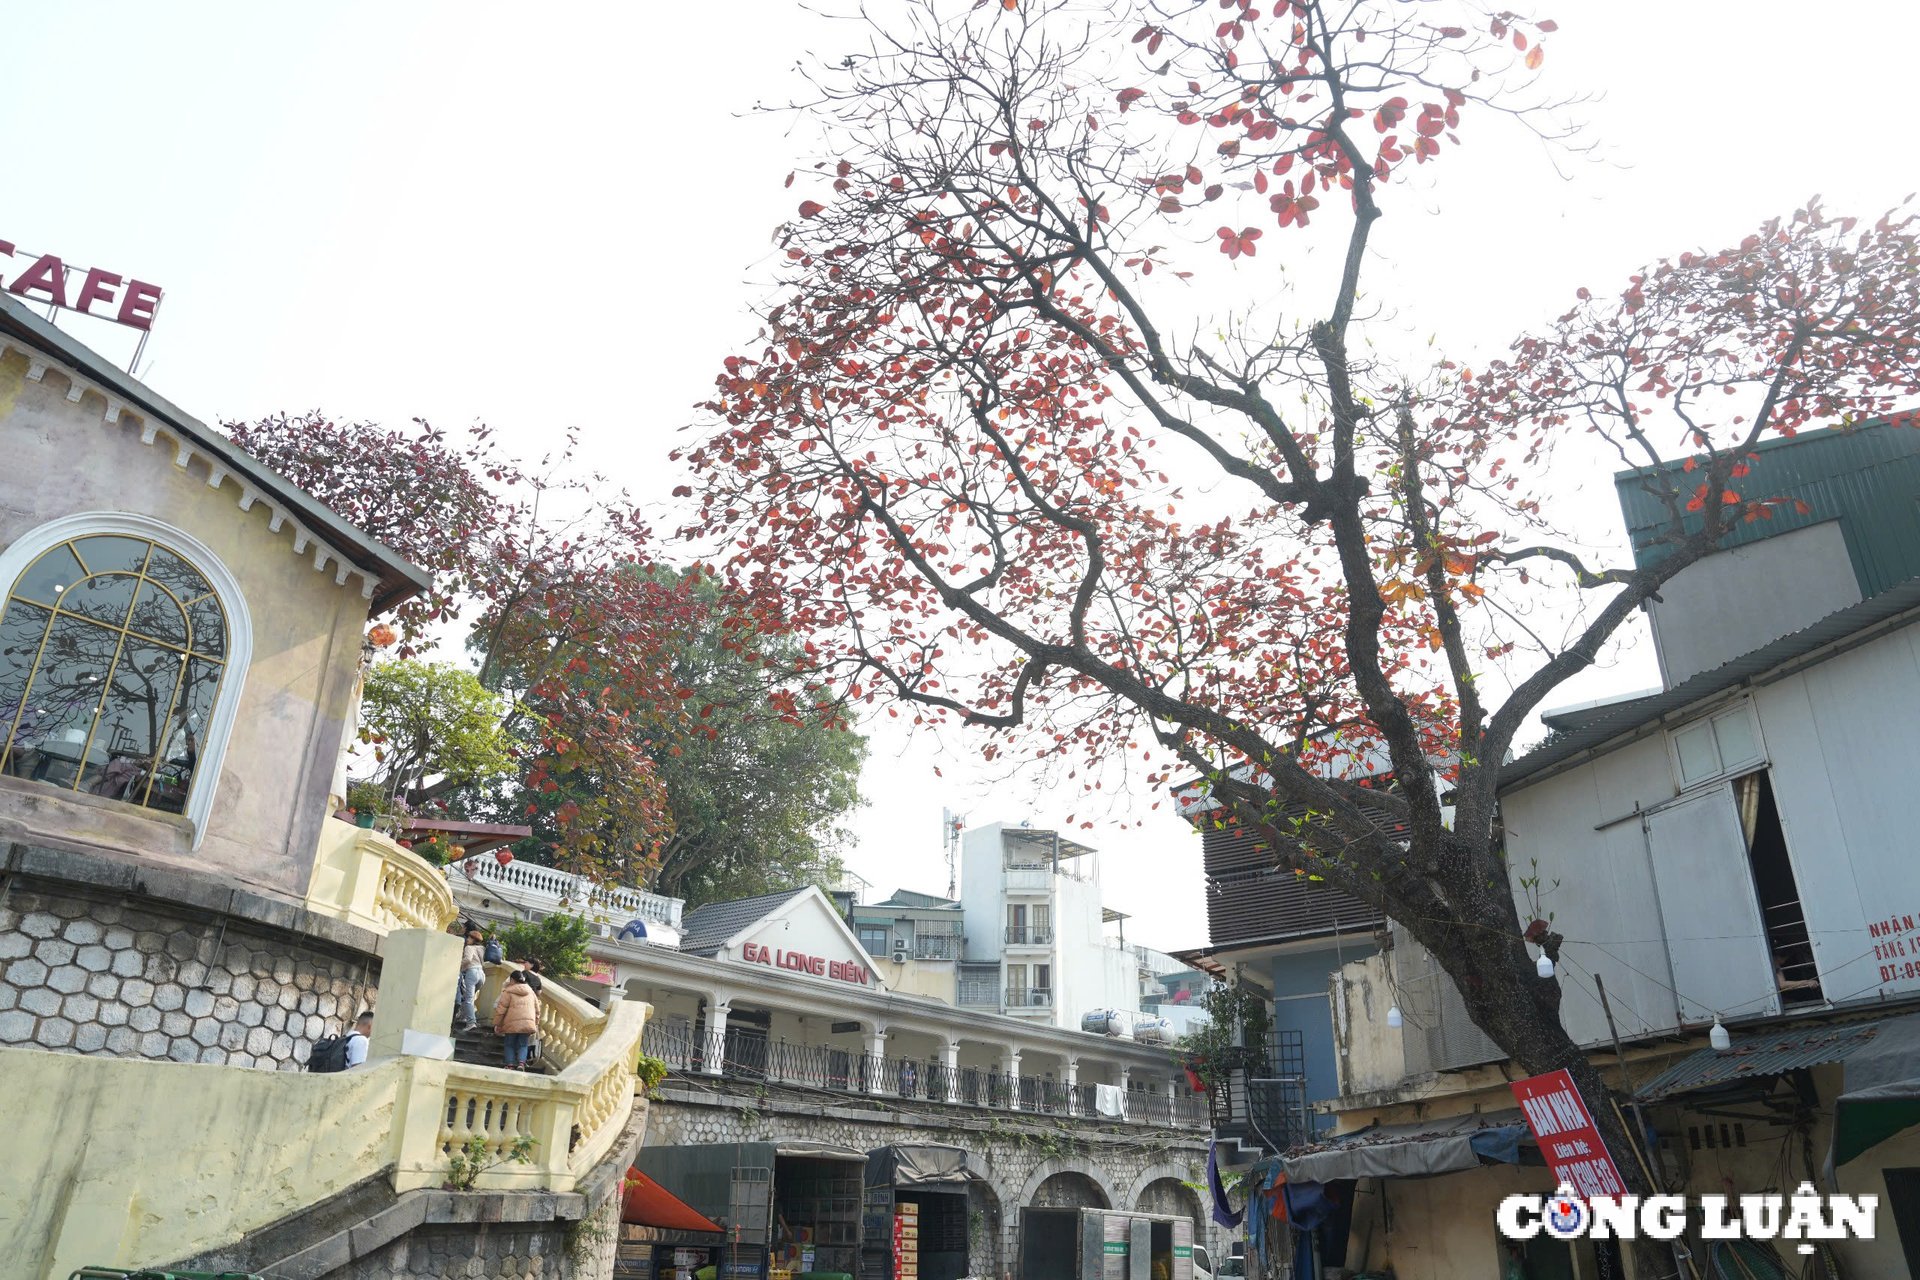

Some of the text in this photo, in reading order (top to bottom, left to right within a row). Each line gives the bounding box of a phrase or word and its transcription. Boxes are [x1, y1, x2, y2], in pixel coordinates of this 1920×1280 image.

[1869, 915, 1915, 938] NHẬN
[743, 942, 869, 985] GA LONG BIÊN
[1522, 1079, 1589, 1137] BÁN NHÀ
[1552, 1142, 1576, 1159] Liên
[1570, 1160, 1605, 1198] 8399
[1591, 1157, 1621, 1194] 513
